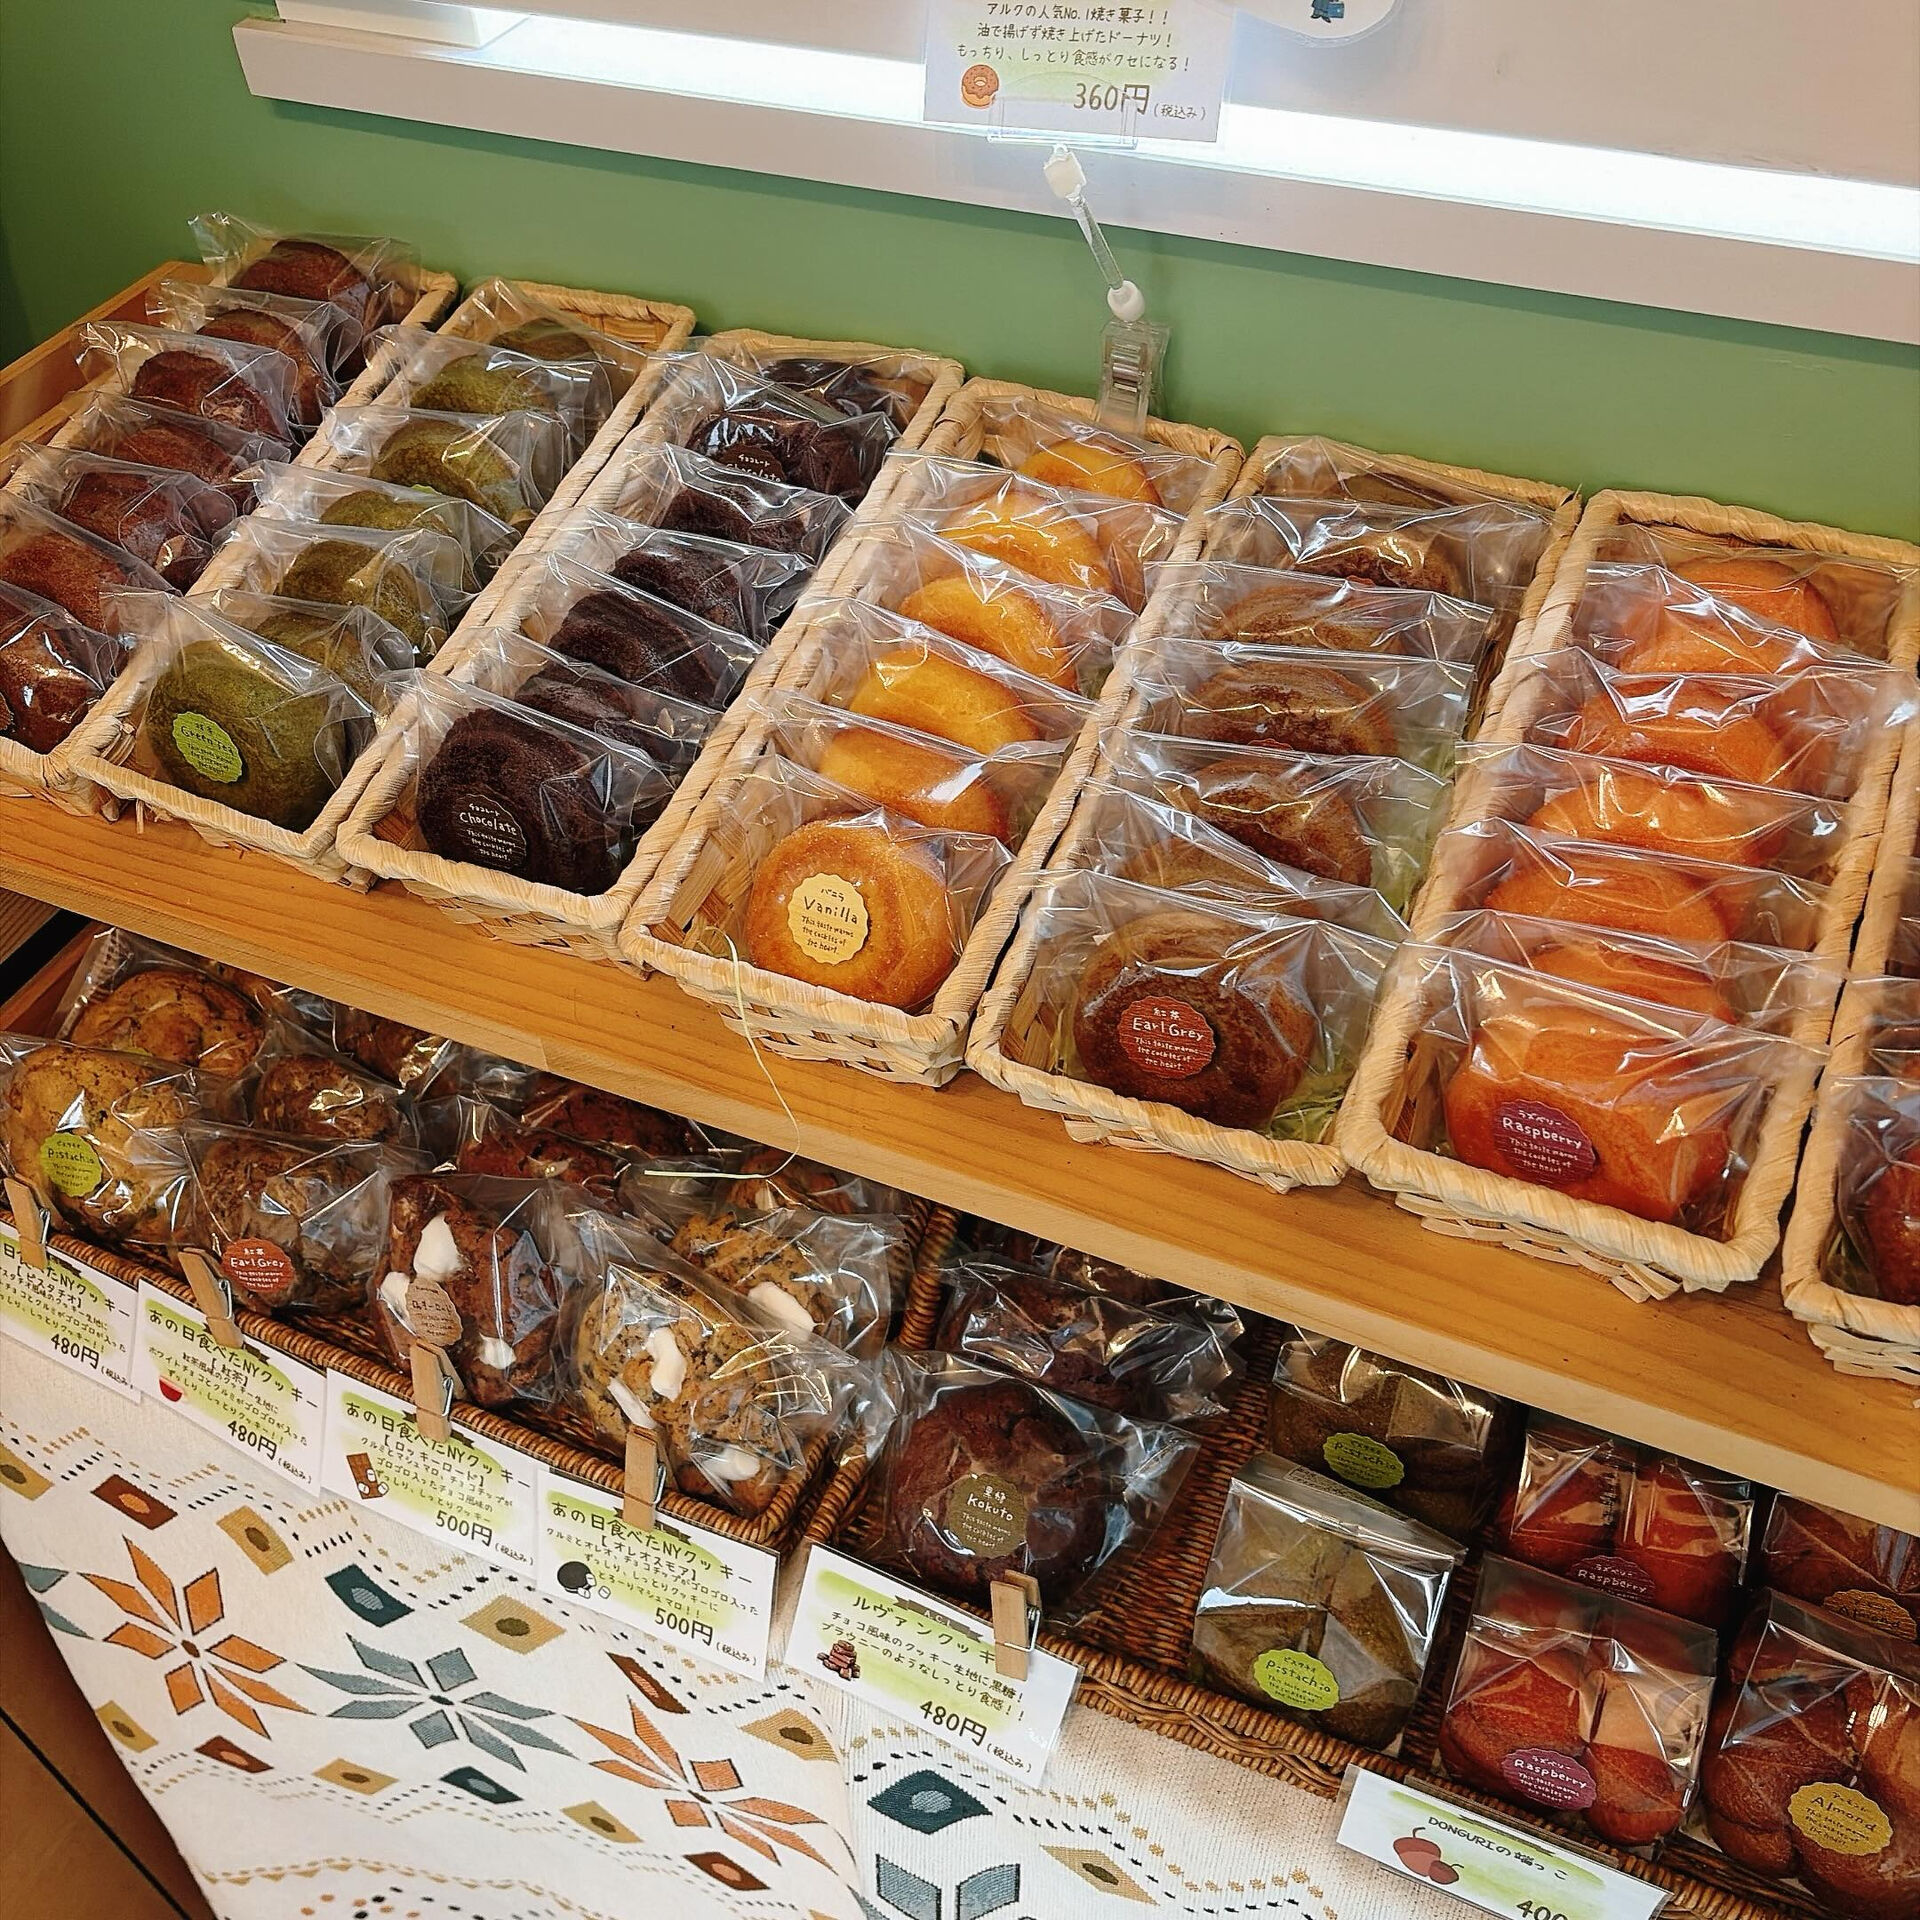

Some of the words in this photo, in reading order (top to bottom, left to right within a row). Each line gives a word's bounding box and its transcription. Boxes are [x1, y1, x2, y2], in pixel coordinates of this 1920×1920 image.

[1073, 82, 1150, 115] 360円
[459, 811, 518, 836] Chocolate
[804, 896, 858, 924] Vanilla
[1132, 1017, 1165, 1033] Earl
[1168, 1023, 1204, 1041] Grey
[1502, 1116, 1582, 1149] Raspberry
[50, 1333, 100, 1370] 480円
[227, 1420, 278, 1461] 480円
[435, 1510, 493, 1547] 500円
[1578, 1569, 1647, 1593] Raspberry
[654, 1607, 714, 1646] 500円
[1266, 1660, 1331, 1693] Pistachio
[919, 1700, 988, 1747] 480円
[1514, 1759, 1587, 1789] Raspberry
[1811, 1796, 1877, 1833] Almond
